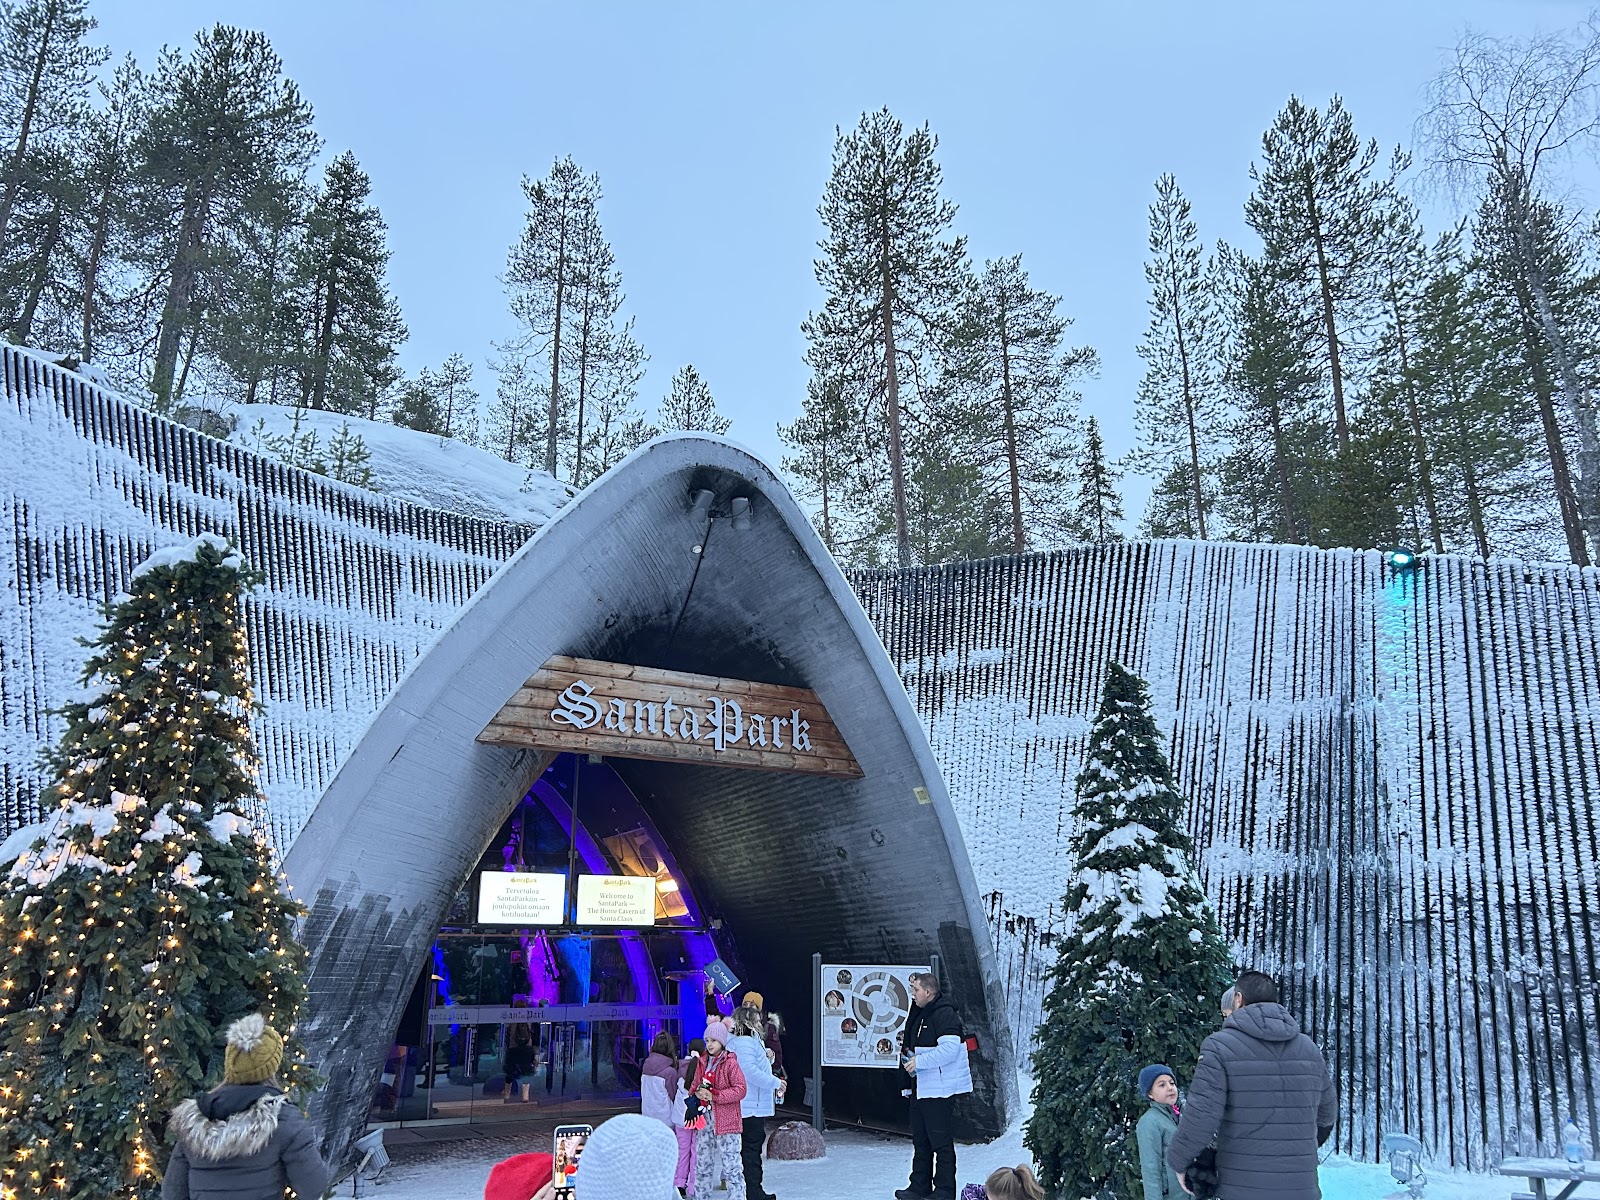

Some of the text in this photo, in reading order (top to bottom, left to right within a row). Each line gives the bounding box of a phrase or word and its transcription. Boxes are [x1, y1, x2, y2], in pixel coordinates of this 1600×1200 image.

[550, 679, 813, 752] SantaPark
[603, 878, 632, 886] SantaPark
[505, 887, 540, 895] Tervetuloa
[492, 903, 527, 911] joulupukin
[429, 1011, 469, 1022] antaPark
